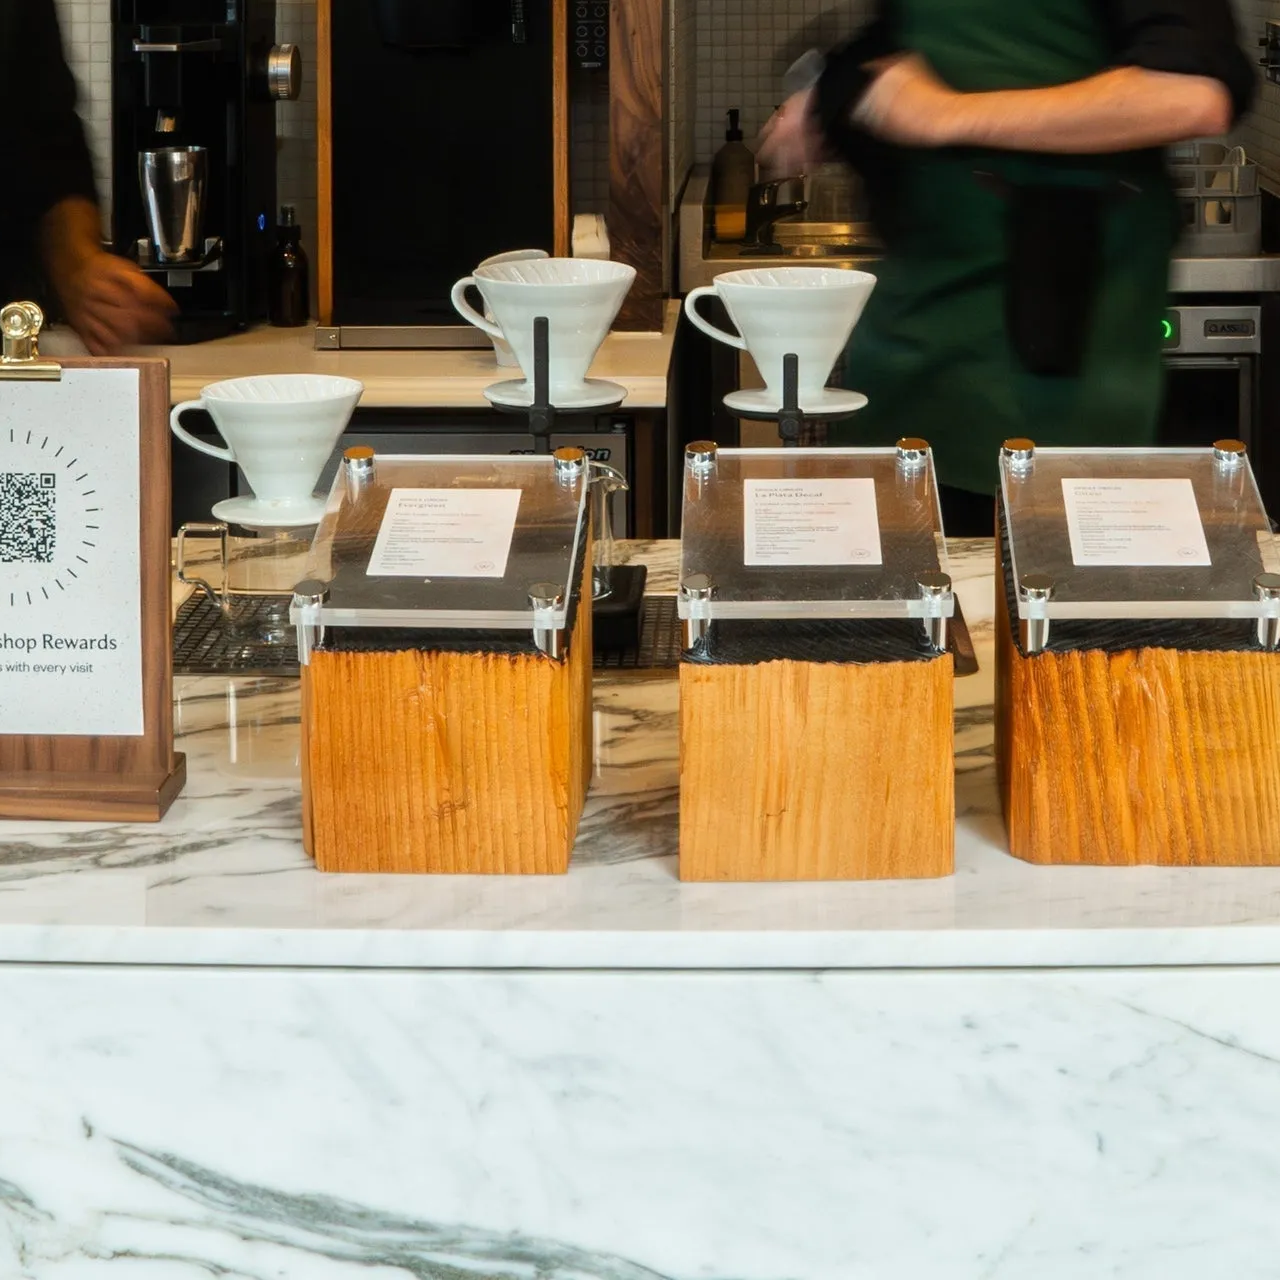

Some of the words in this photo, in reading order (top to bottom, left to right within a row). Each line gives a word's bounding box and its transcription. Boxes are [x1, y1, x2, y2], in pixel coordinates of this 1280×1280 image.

[42, 633, 118, 650] Rewards
[5, 661, 30, 672] with
[32, 663, 67, 675] every
[69, 662, 94, 673] visit
